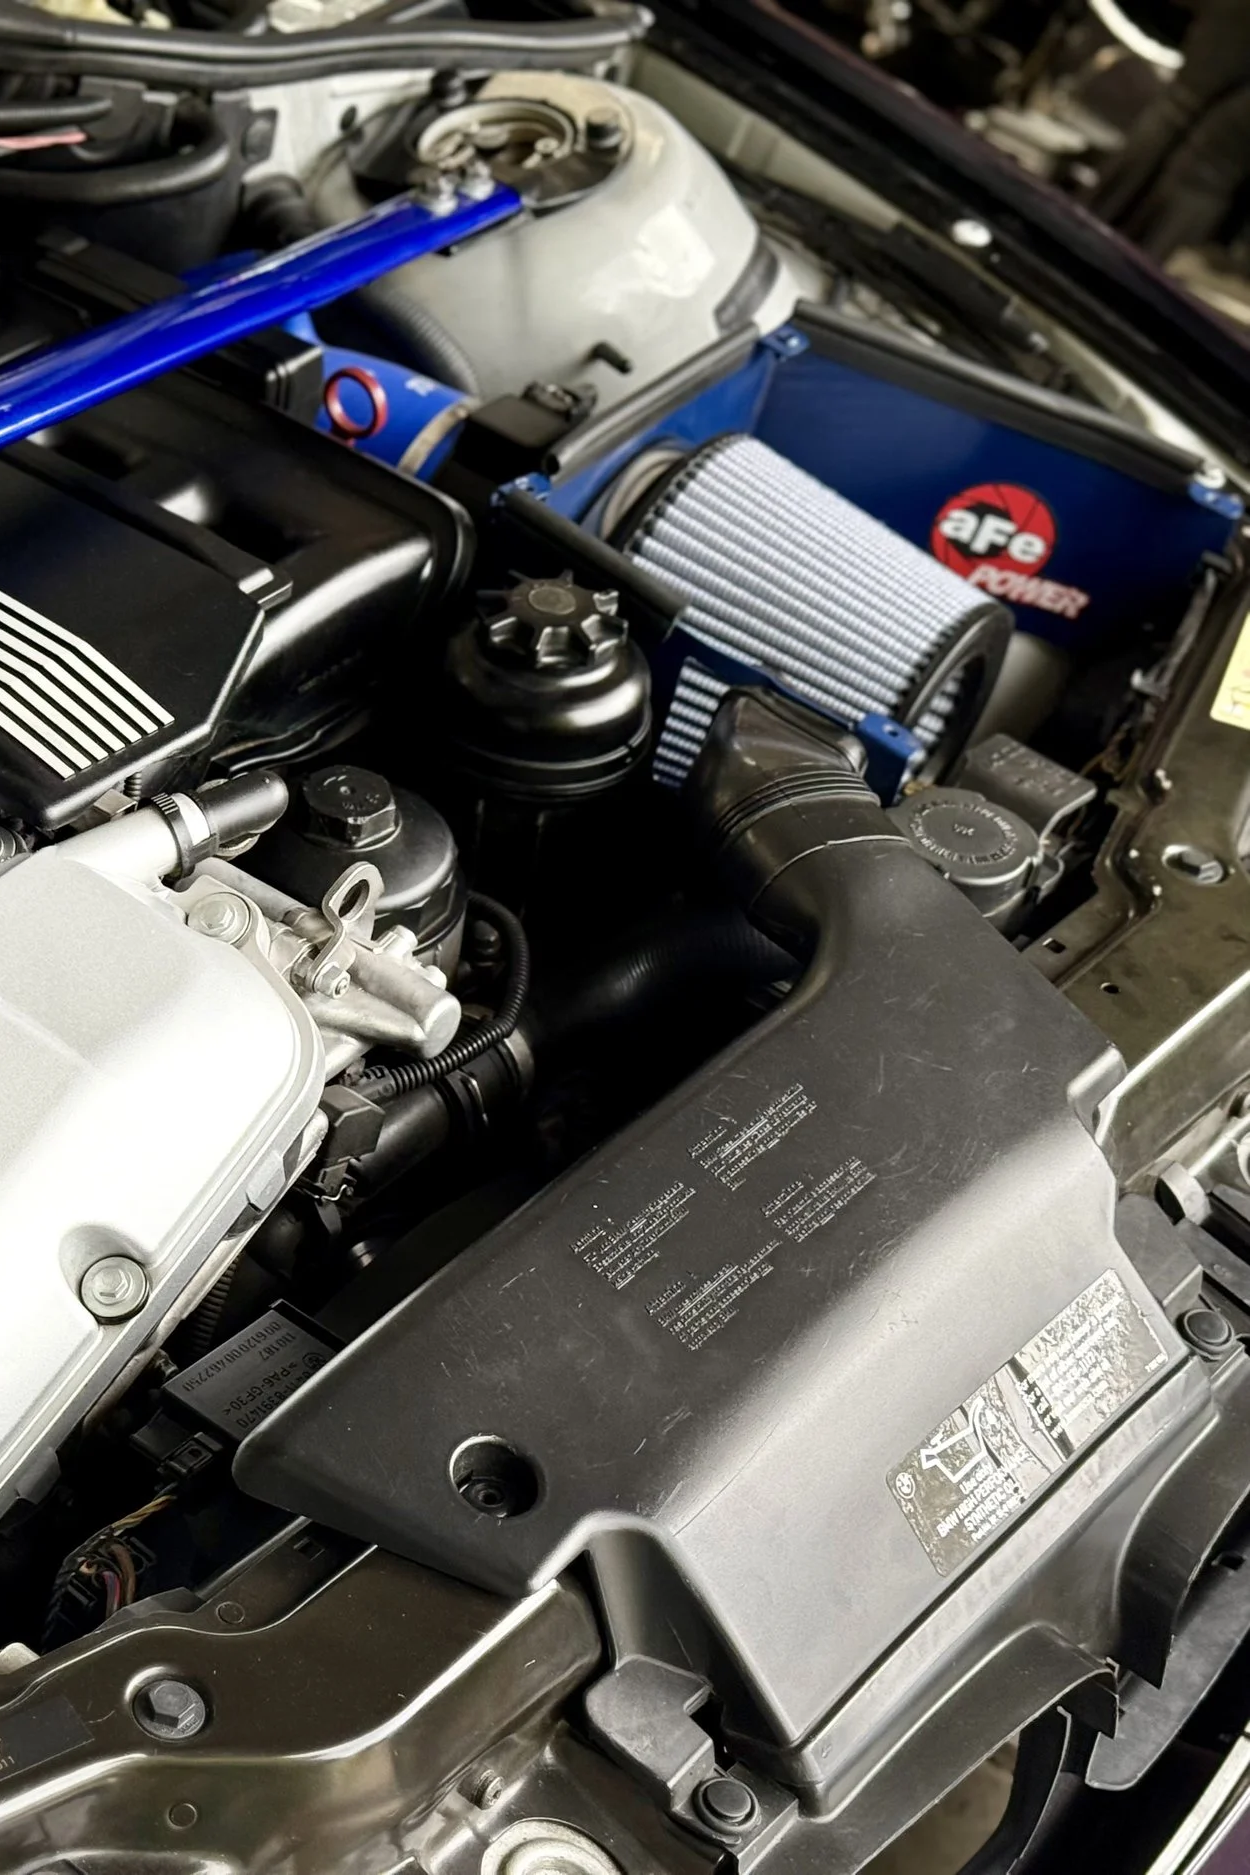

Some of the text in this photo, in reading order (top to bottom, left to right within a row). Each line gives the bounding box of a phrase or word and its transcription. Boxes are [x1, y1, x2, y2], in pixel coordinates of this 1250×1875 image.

[939, 508, 1047, 564] aFe
[969, 564, 1091, 620] POWER
[959, 1477, 977, 1494] Use
[936, 1511, 959, 1538] BMW
[955, 1494, 978, 1519] HIGH
[964, 1487, 1007, 1532] SYNTHETIC
